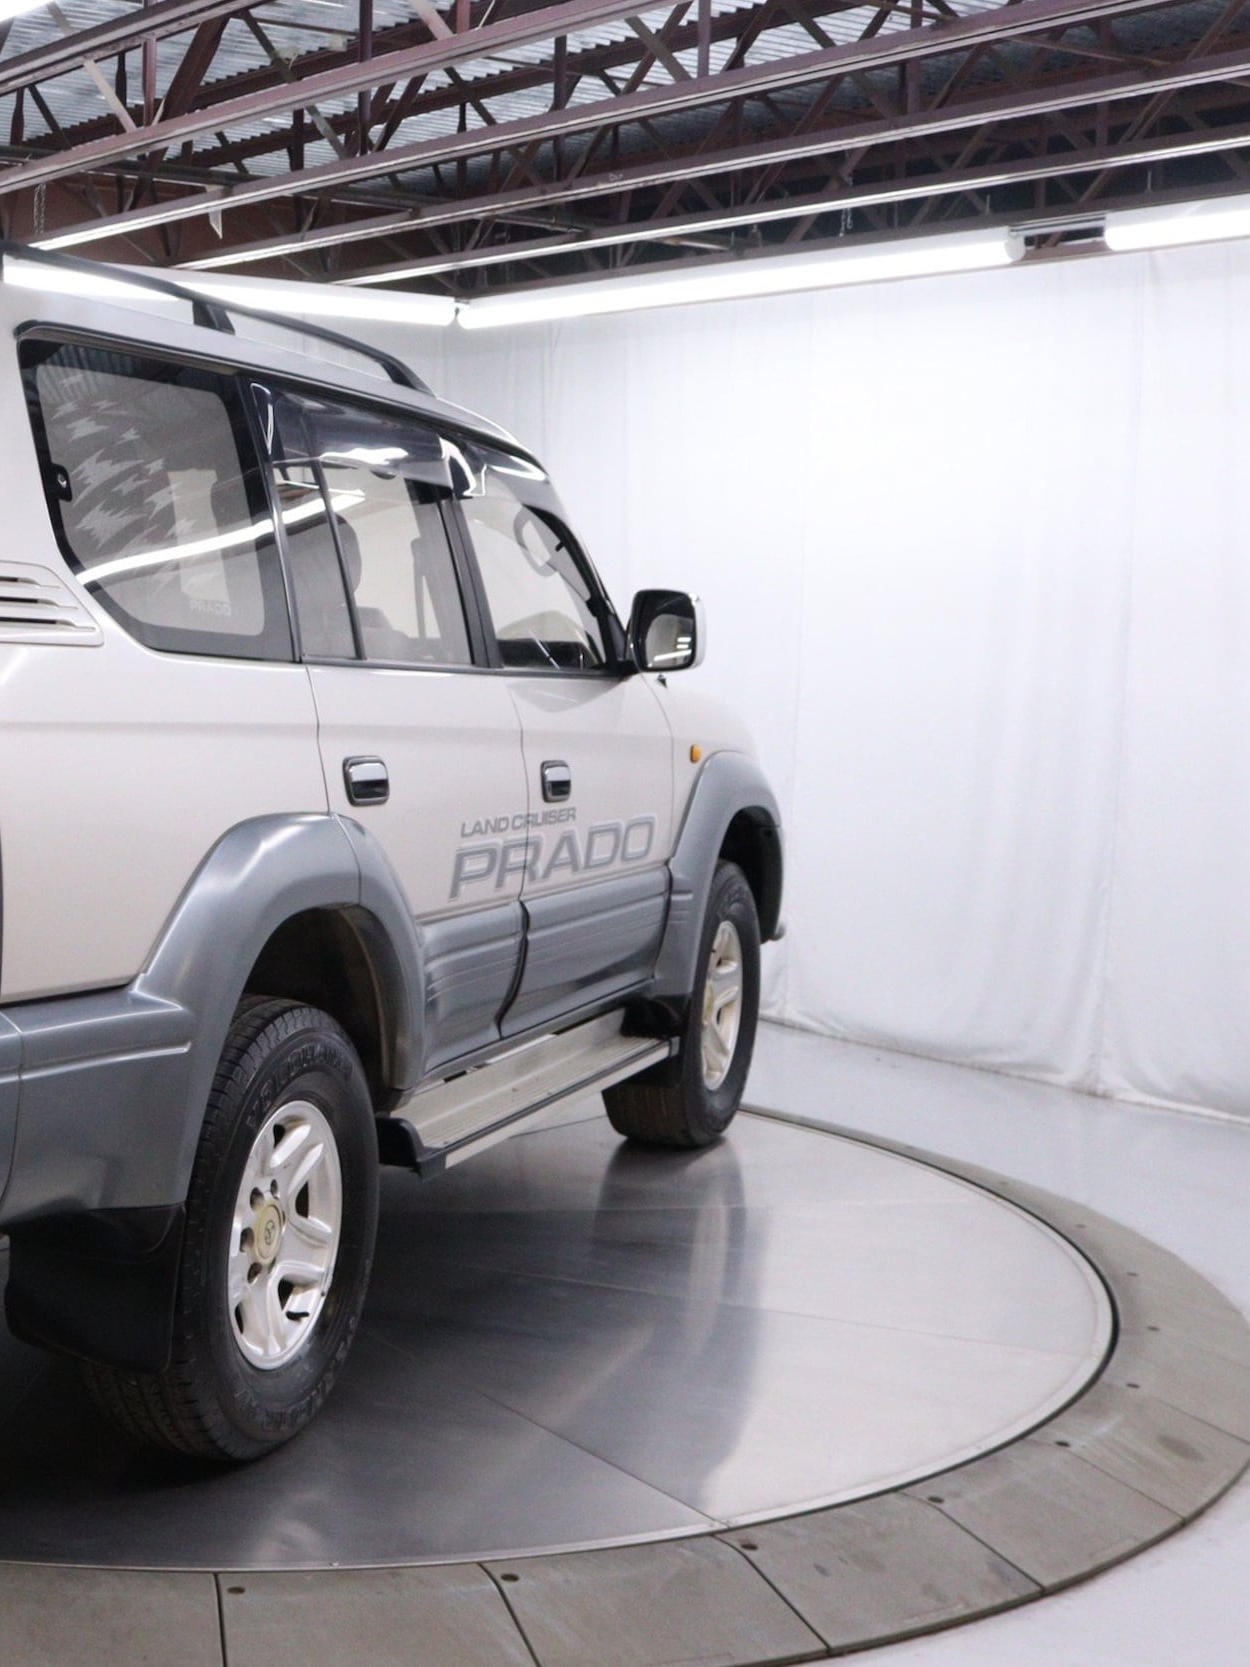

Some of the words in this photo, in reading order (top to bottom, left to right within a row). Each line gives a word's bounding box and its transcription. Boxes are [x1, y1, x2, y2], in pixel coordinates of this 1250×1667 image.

[461, 816, 510, 838] LAND
[511, 806, 576, 831] CRUISER
[450, 815, 655, 898] PRADO
